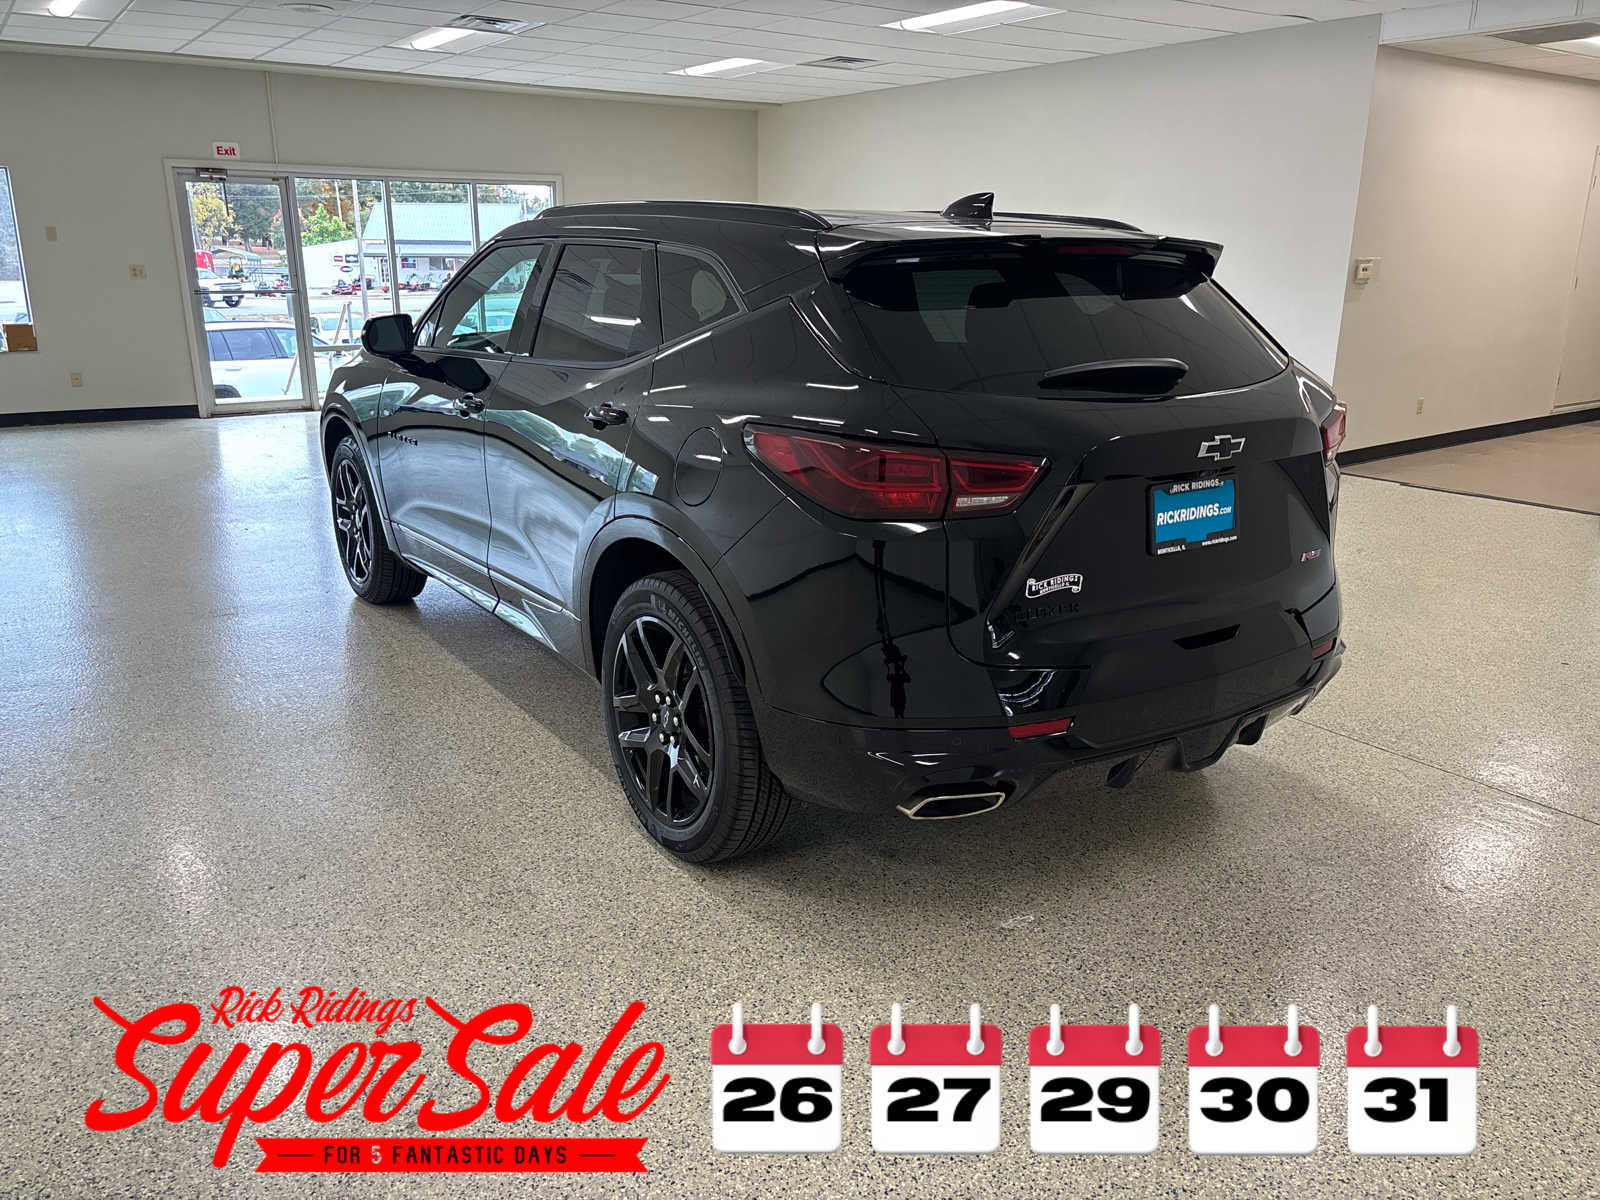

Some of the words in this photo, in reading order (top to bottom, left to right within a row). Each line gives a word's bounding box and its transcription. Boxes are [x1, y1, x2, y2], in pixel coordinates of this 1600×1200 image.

[216, 145, 237, 156] Exit
[1173, 483, 1189, 493] RICK
[1192, 479, 1218, 489] RIDINGS
[1157, 503, 1231, 526] RICKRIDINGS.COM
[1031, 582, 1048, 592] RICK
